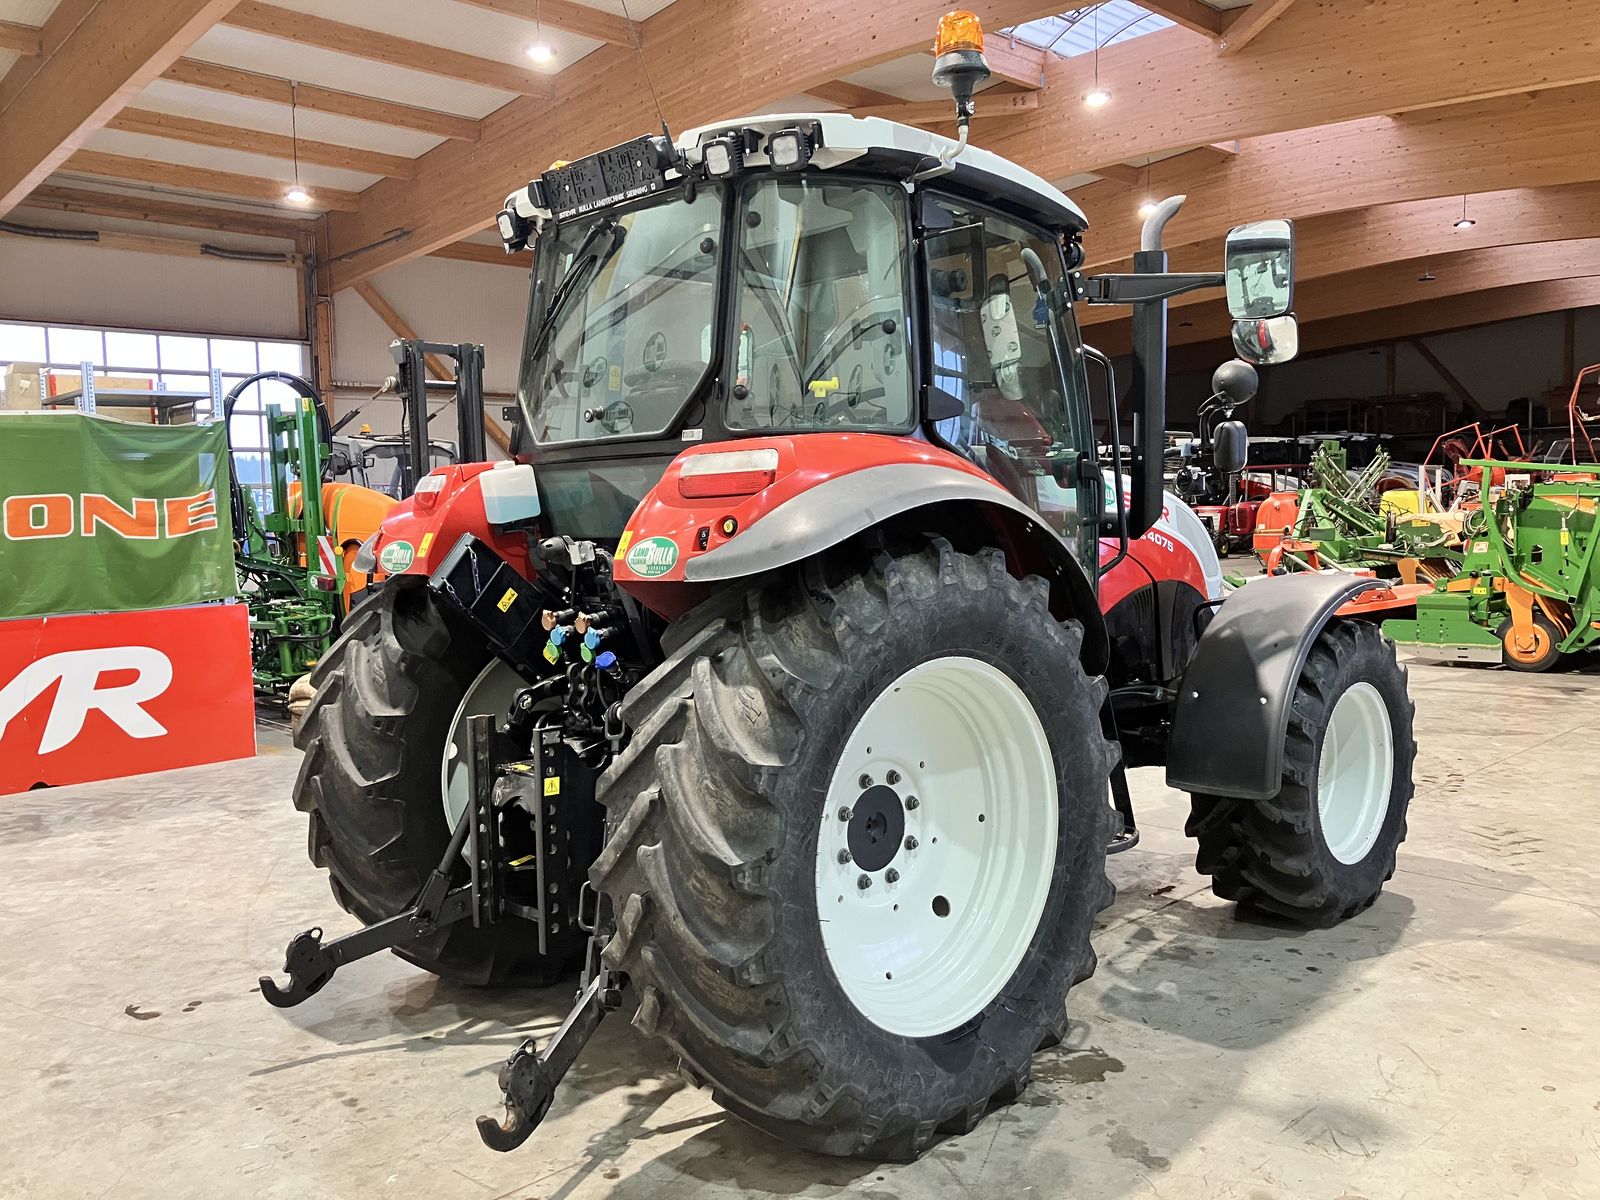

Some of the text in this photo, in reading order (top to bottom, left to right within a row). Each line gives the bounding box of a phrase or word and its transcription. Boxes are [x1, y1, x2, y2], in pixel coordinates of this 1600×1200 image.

[559, 208, 576, 220] STEYR
[578, 203, 593, 213] BULLA
[593, 192, 625, 209] LANDTECHNIK
[3, 488, 218, 540] ONE
[633, 547, 649, 558] LAND
[646, 541, 674, 565] BULLA
[1147, 531, 1174, 553] 4075
